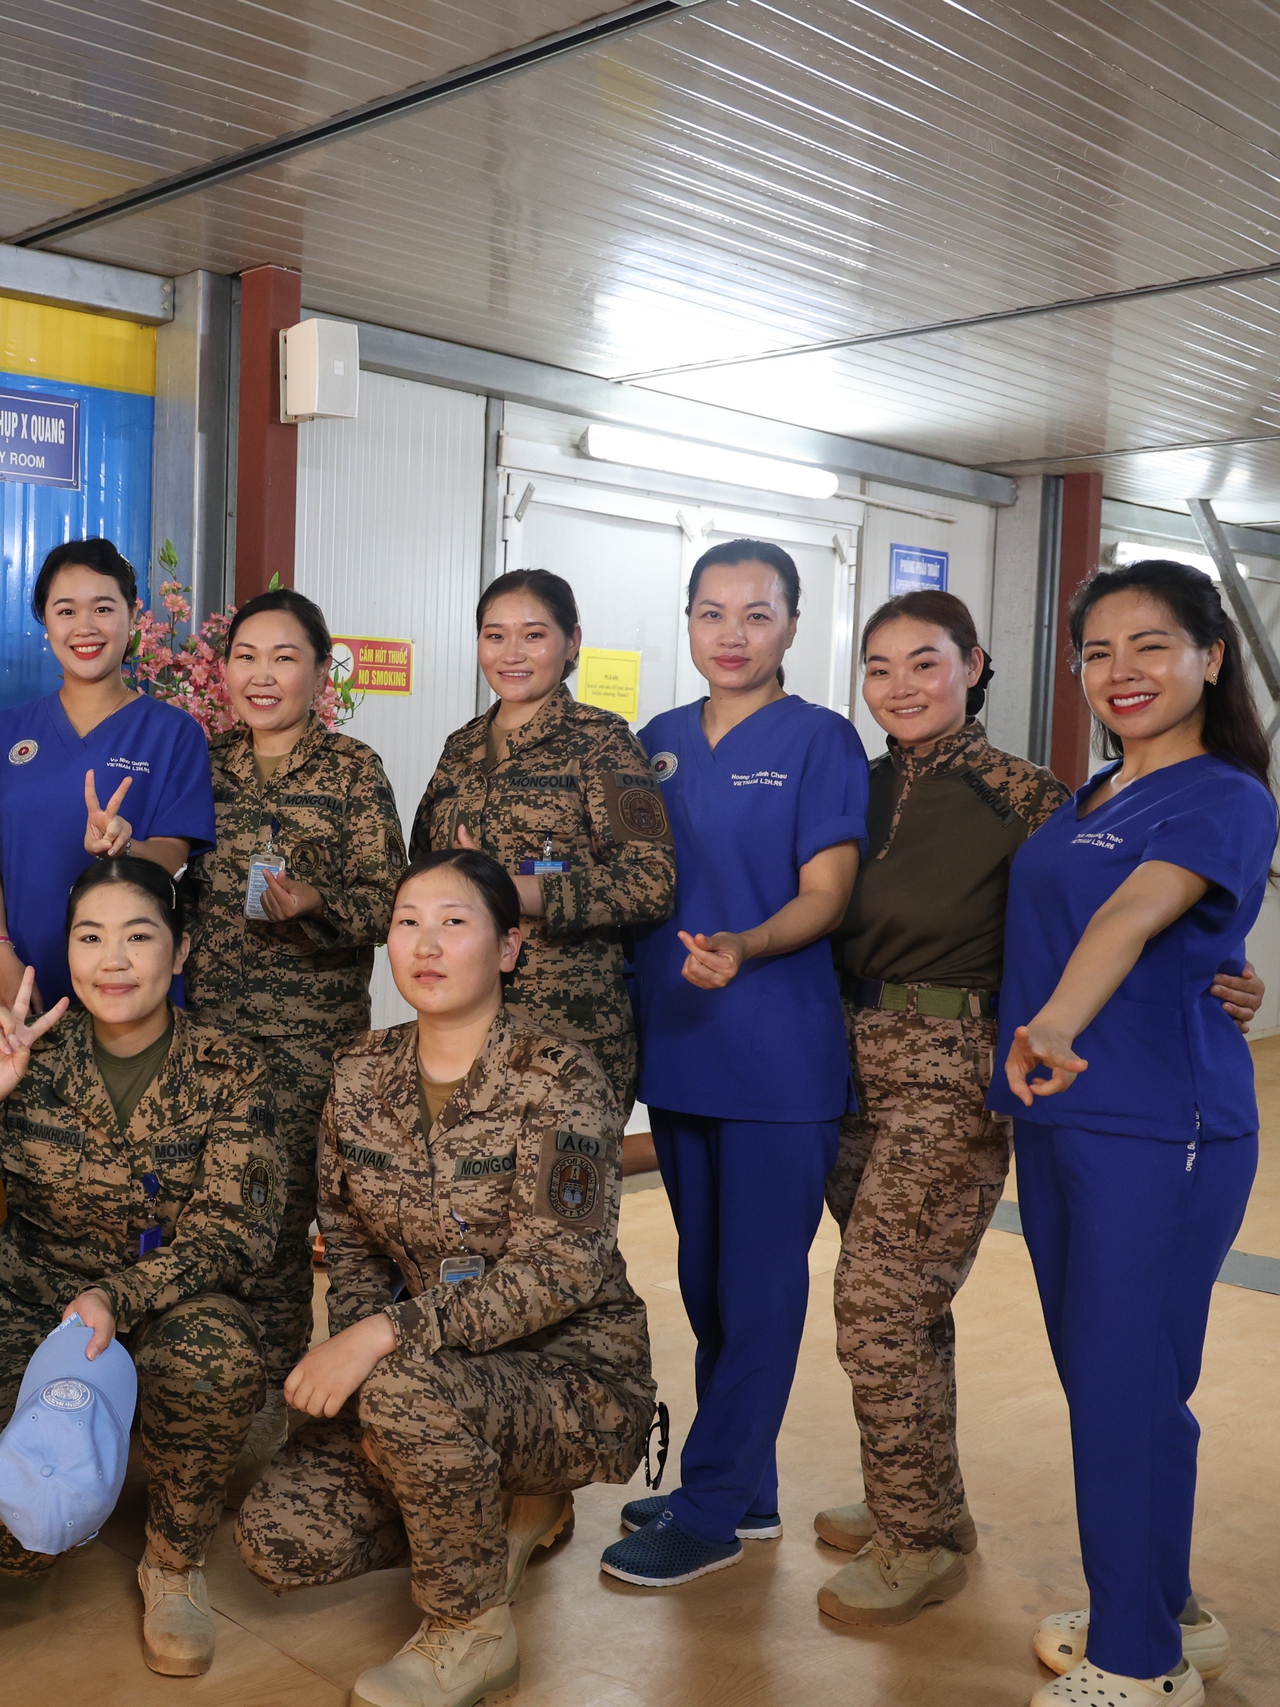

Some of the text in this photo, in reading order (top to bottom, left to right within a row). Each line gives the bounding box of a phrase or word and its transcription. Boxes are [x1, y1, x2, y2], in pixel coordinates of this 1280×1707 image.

[21, 413, 28, 440] X
[30, 414, 65, 445] QUANG
[9, 451, 46, 469] ROOM
[359, 644, 408, 665] CẤM HÚT THUỐC
[358, 669, 406, 687] NO SMOKING
[509, 775, 577, 789] MONGOLIA
[770, 771, 788, 779] Chau
[284, 794, 344, 813] MONGOLIA
[961, 770, 1011, 821] MONGOLIA
[1106, 833, 1124, 844] Thao
[154, 1142, 200, 1159] MONG
[562, 1135, 600, 1156] A(+)
[461, 1157, 514, 1176] MONGO
[1185, 1151, 1196, 1172] Thao
